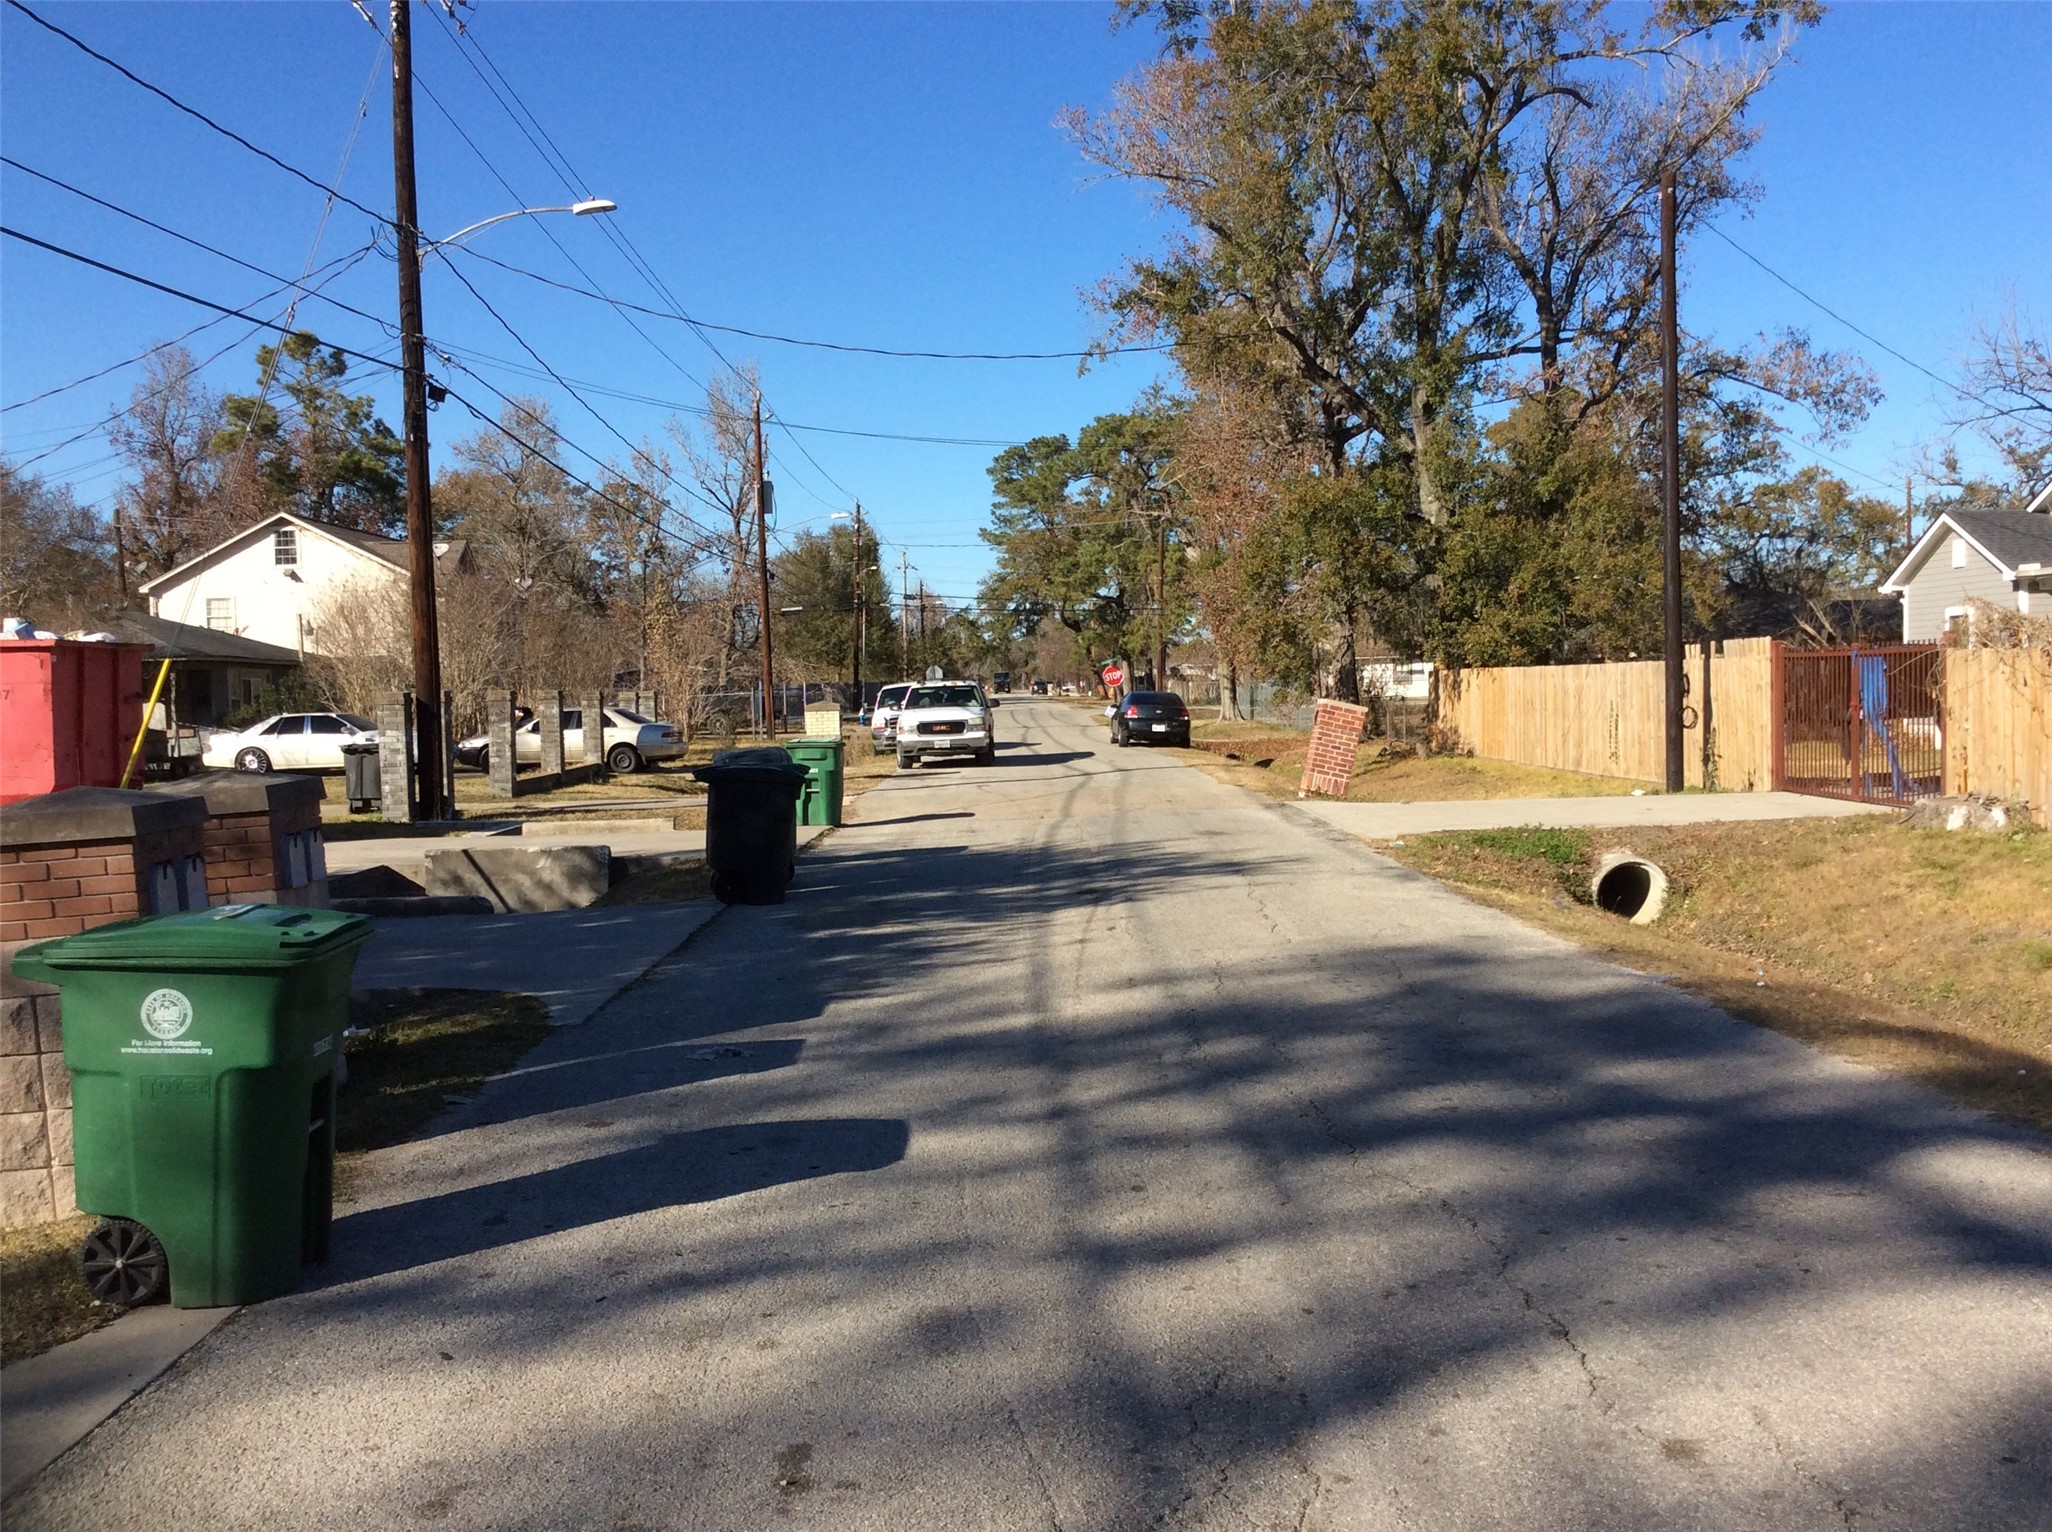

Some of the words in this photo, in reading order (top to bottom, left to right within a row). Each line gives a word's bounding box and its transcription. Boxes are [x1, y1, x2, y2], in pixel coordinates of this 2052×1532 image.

[1105, 670, 1122, 682] STOP
[144, 1039, 162, 1047] More
[163, 1039, 201, 1047] Information
[121, 1047, 213, 1055] www.houstonsolidwaste.org
